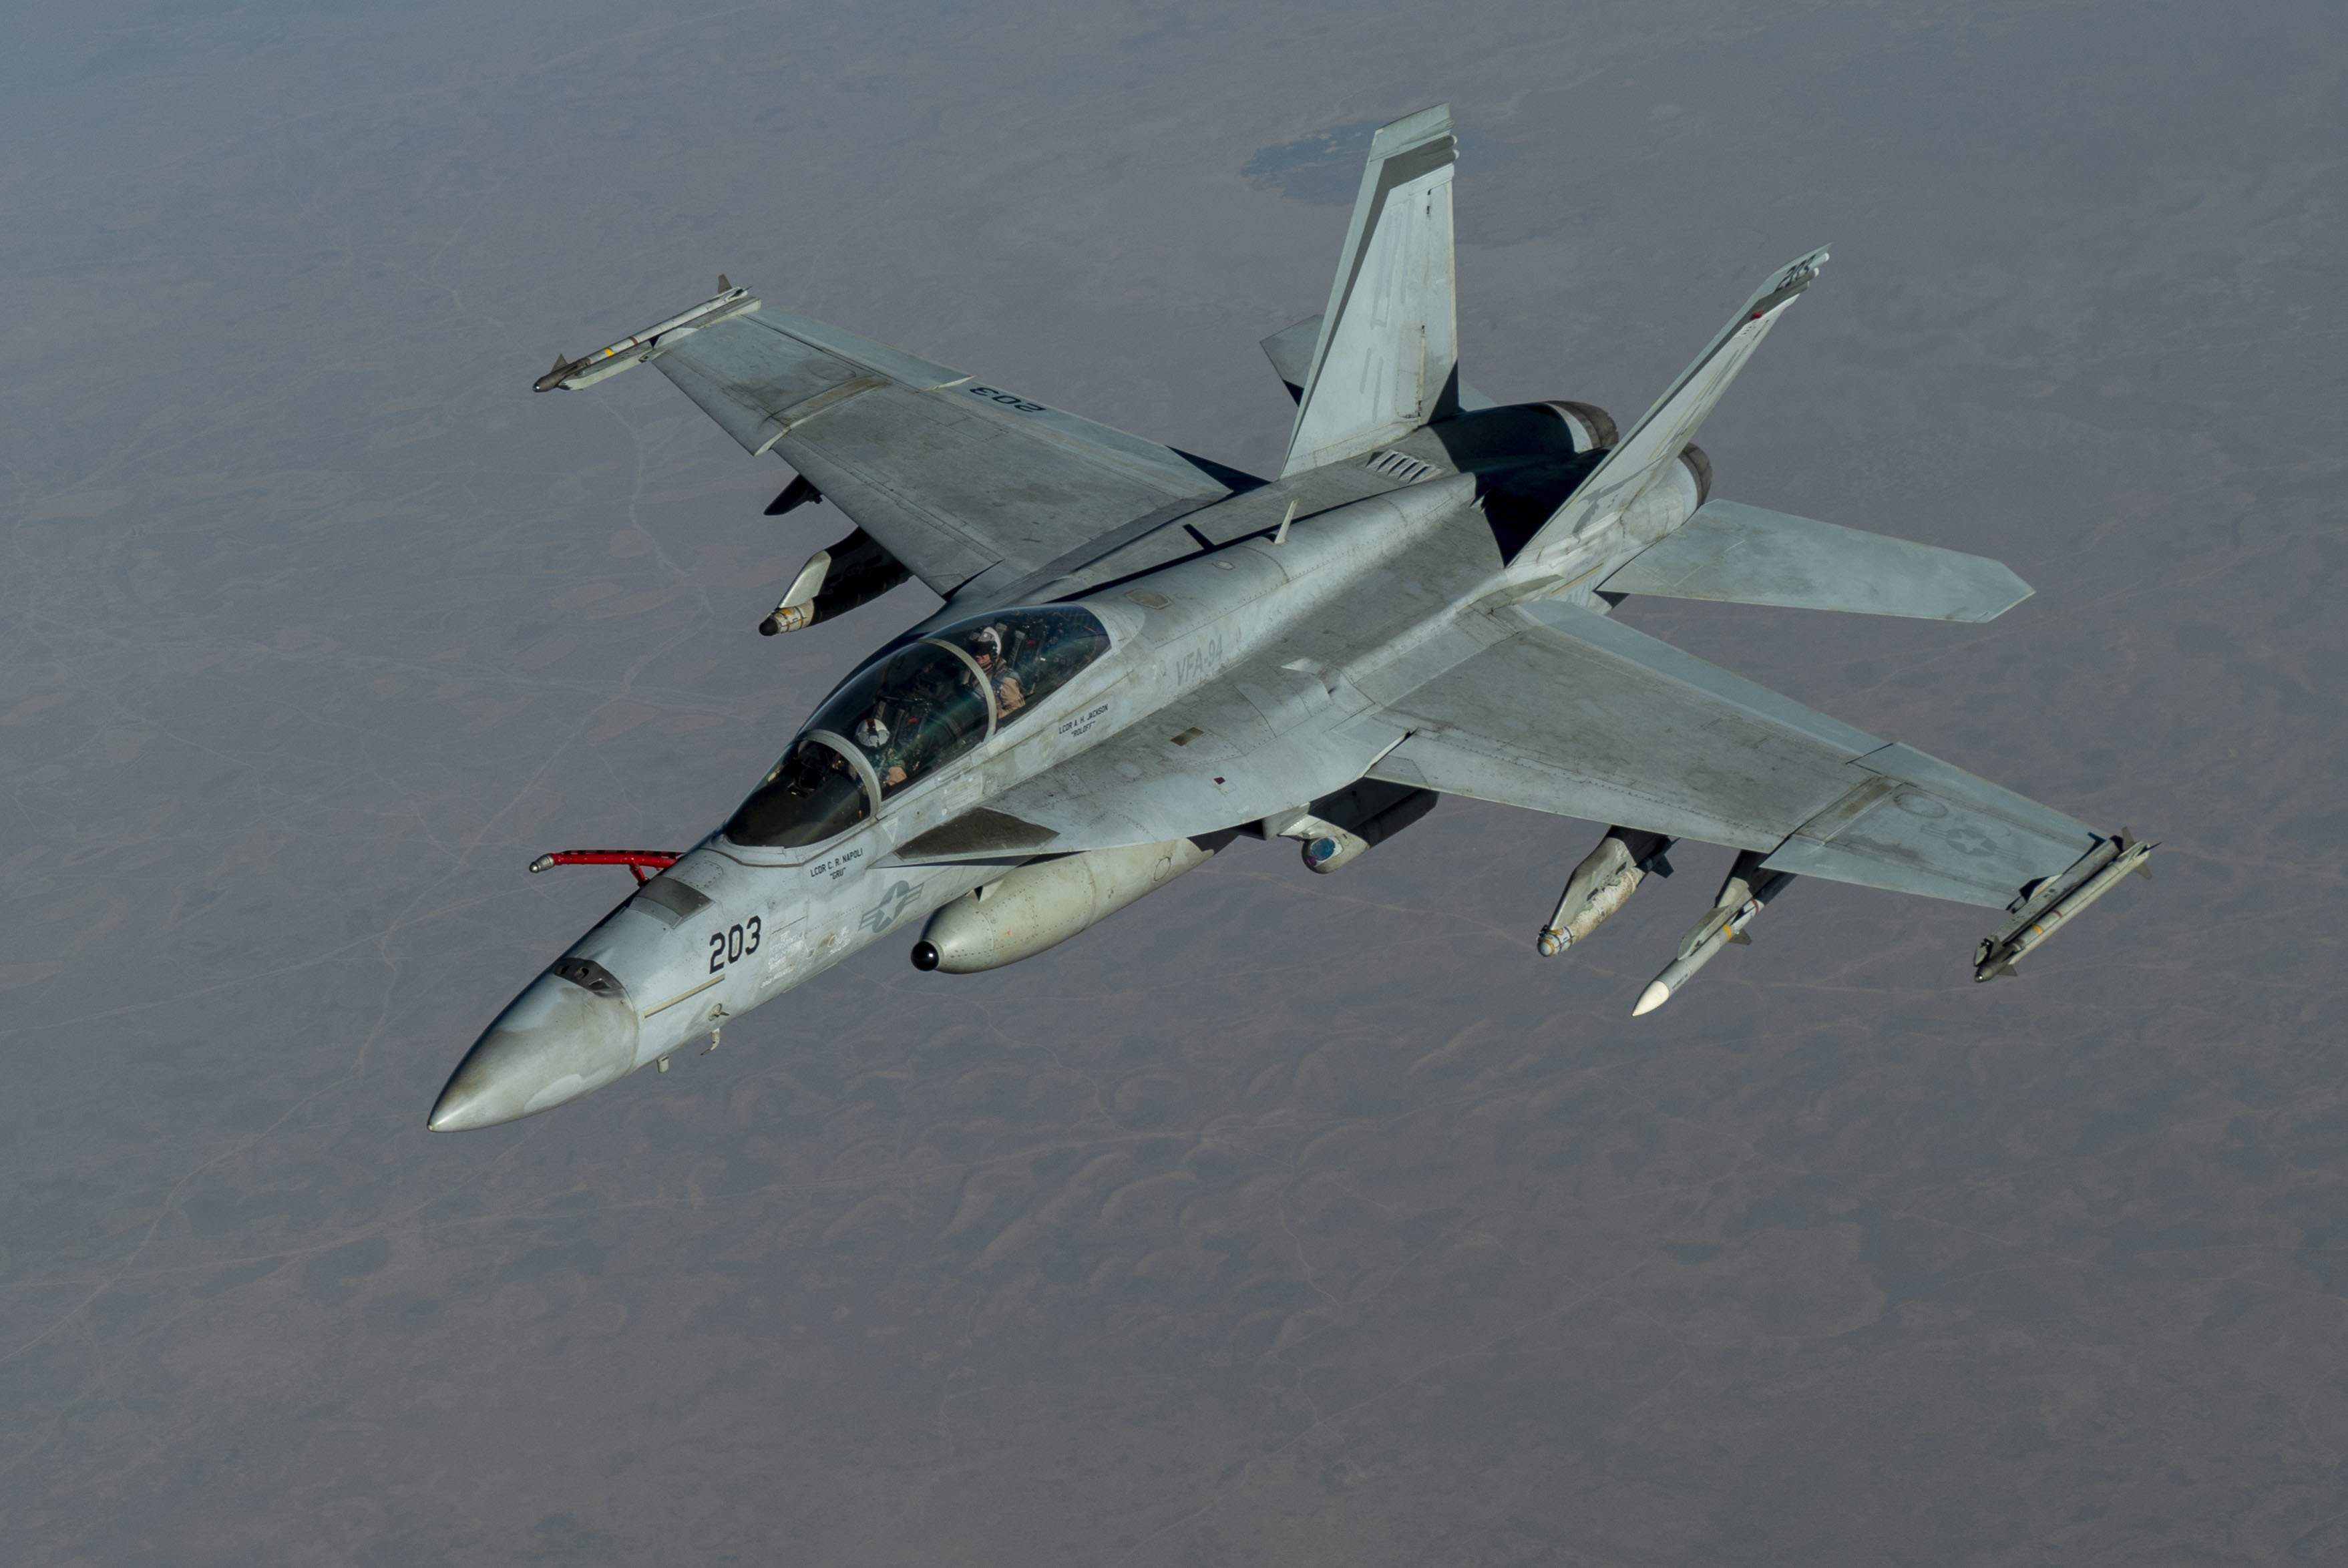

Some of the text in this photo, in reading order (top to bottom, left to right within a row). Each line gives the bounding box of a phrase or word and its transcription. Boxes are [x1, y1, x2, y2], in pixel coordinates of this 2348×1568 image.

[969, 387, 1046, 412] 203
[1175, 633, 1223, 687] VFA-94
[1058, 722, 1072, 734] LCDR
[1087, 704, 1108, 720] JACKSON
[810, 864, 826, 877] LCDR
[835, 858, 841, 866] R.
[842, 848, 863, 863] NAPOLI
[709, 915, 761, 974] 203
